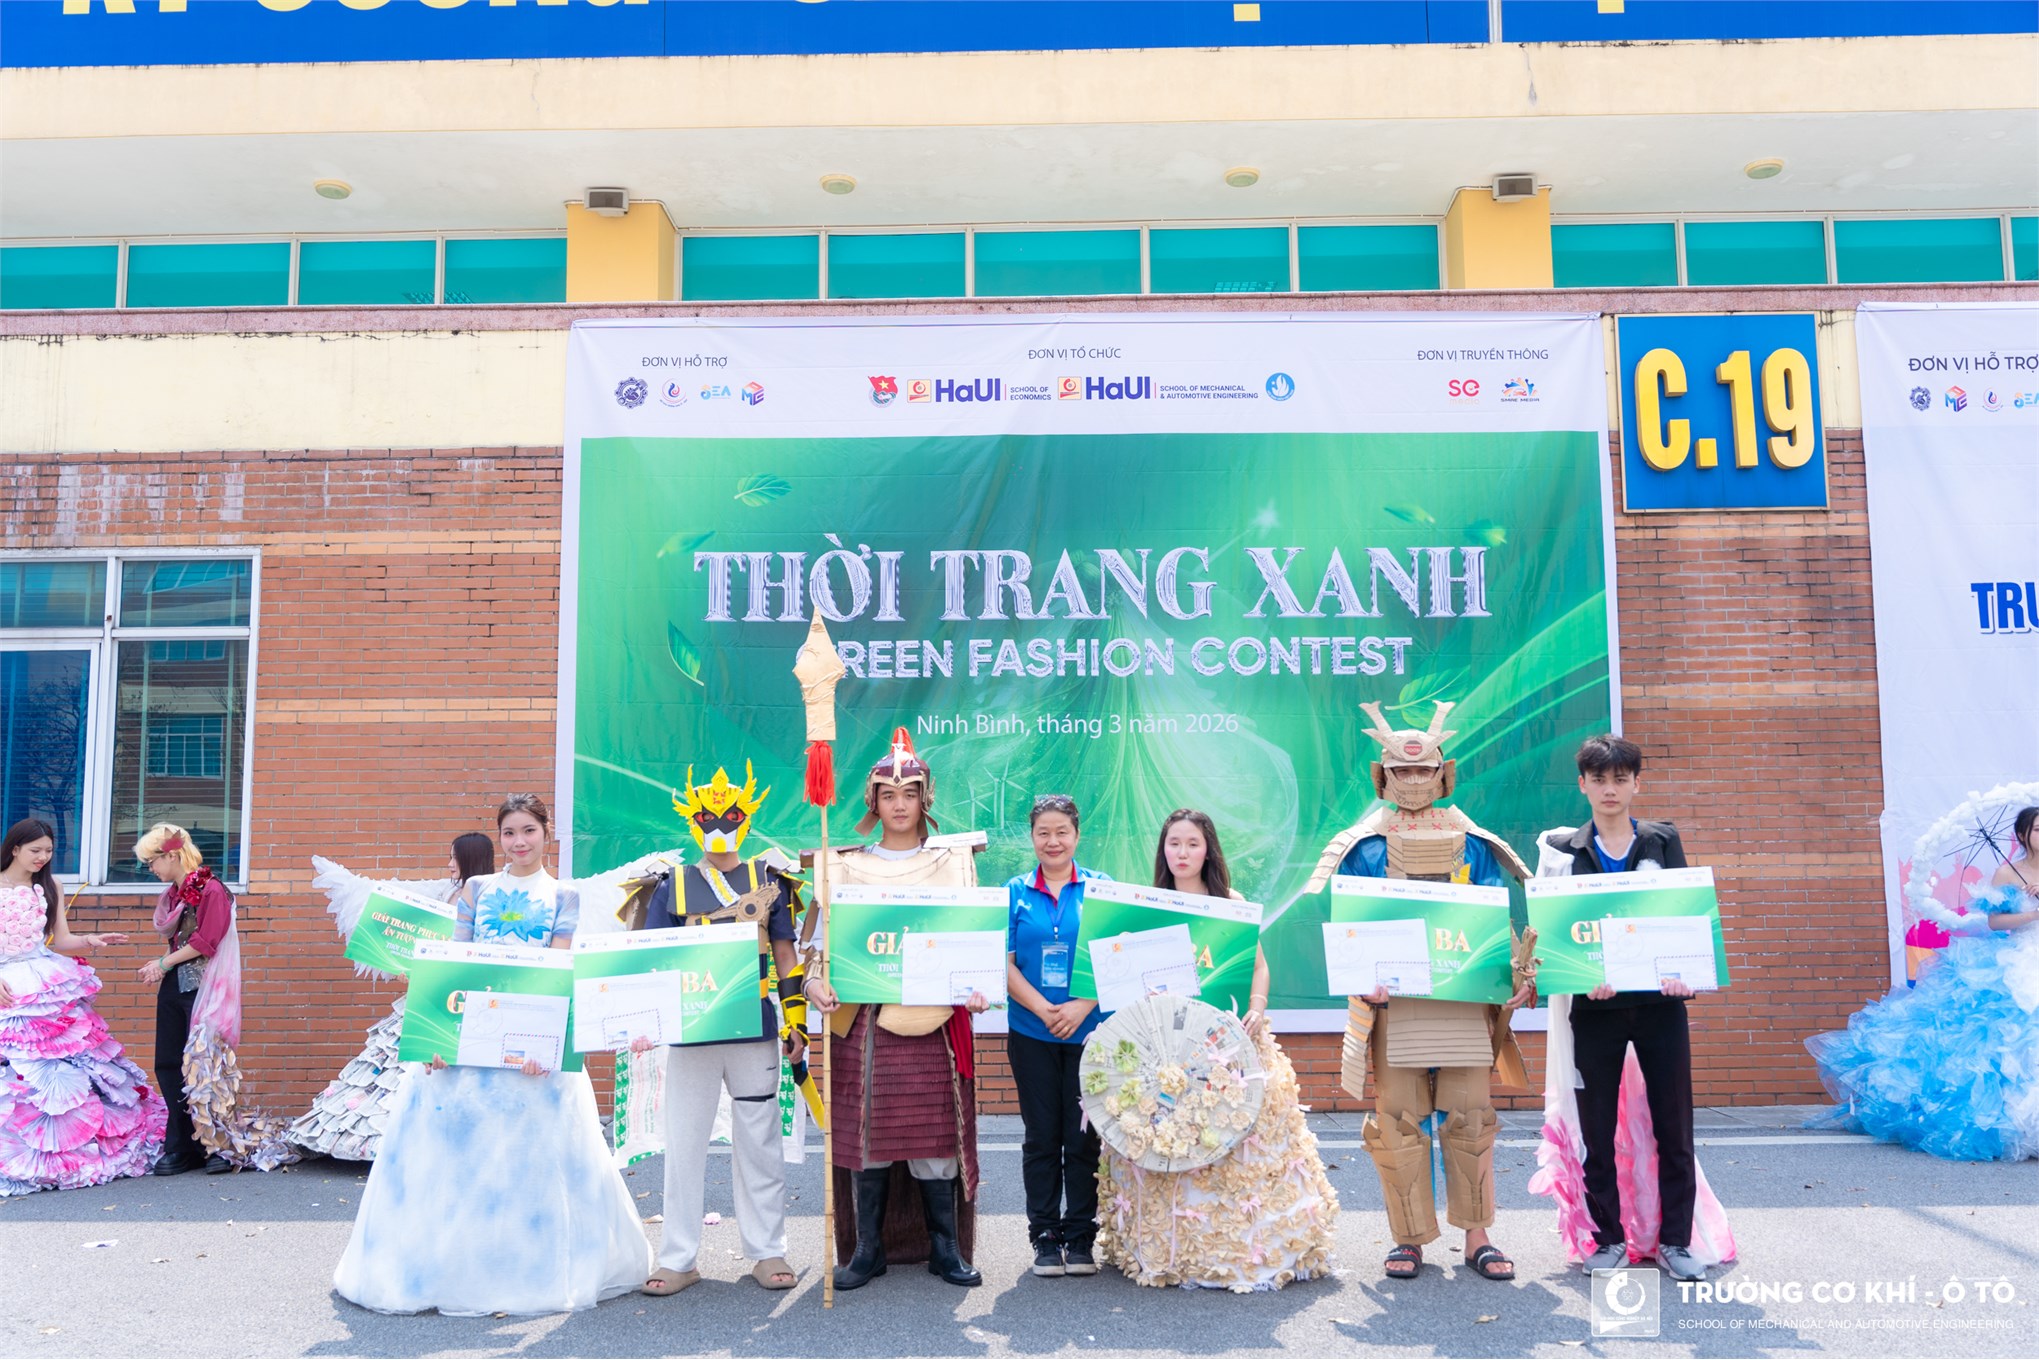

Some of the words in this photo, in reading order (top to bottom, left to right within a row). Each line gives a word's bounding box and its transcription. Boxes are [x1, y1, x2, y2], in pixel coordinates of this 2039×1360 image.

[642, 355, 668, 367] ĐƠN
[671, 356, 682, 368] VỊ
[684, 354, 702, 367] HỖ
[704, 356, 728, 368] TRỢ
[1028, 348, 1054, 359] ĐƠN
[1057, 349, 1068, 360] VỊ
[1070, 345, 1086, 359] TỔ
[1089, 346, 1121, 359] CHỨC
[1417, 349, 1444, 360] ĐƠN
[1446, 350, 1457, 362] VỊ
[1507, 348, 1549, 360] THÔNG
[1908, 355, 1948, 371] ĐƠN
[1953, 357, 1969, 374] VỊ
[1975, 351, 2000, 371] HỖ
[2004, 354, 2039, 373] TRỢ
[935, 378, 1000, 402] HaUI
[1085, 376, 1151, 400] HaUI
[1635, 347, 1815, 471] C.19
[694, 532, 906, 622] THỜI
[930, 546, 1217, 621] TRANG
[1243, 546, 1493, 619] XANH
[796, 639, 954, 678] REEN
[968, 637, 1175, 678] FASHION
[1190, 636, 1413, 676] CONTEST
[917, 714, 968, 734] Ninh
[976, 713, 1031, 737] Bình,
[1036, 713, 1103, 739] tháng
[1109, 714, 1122, 734] 3
[1129, 712, 1178, 734] năm
[1185, 713, 1238, 733] 2026
[1434, 928, 1472, 953] BA
[682, 969, 720, 994] BA
